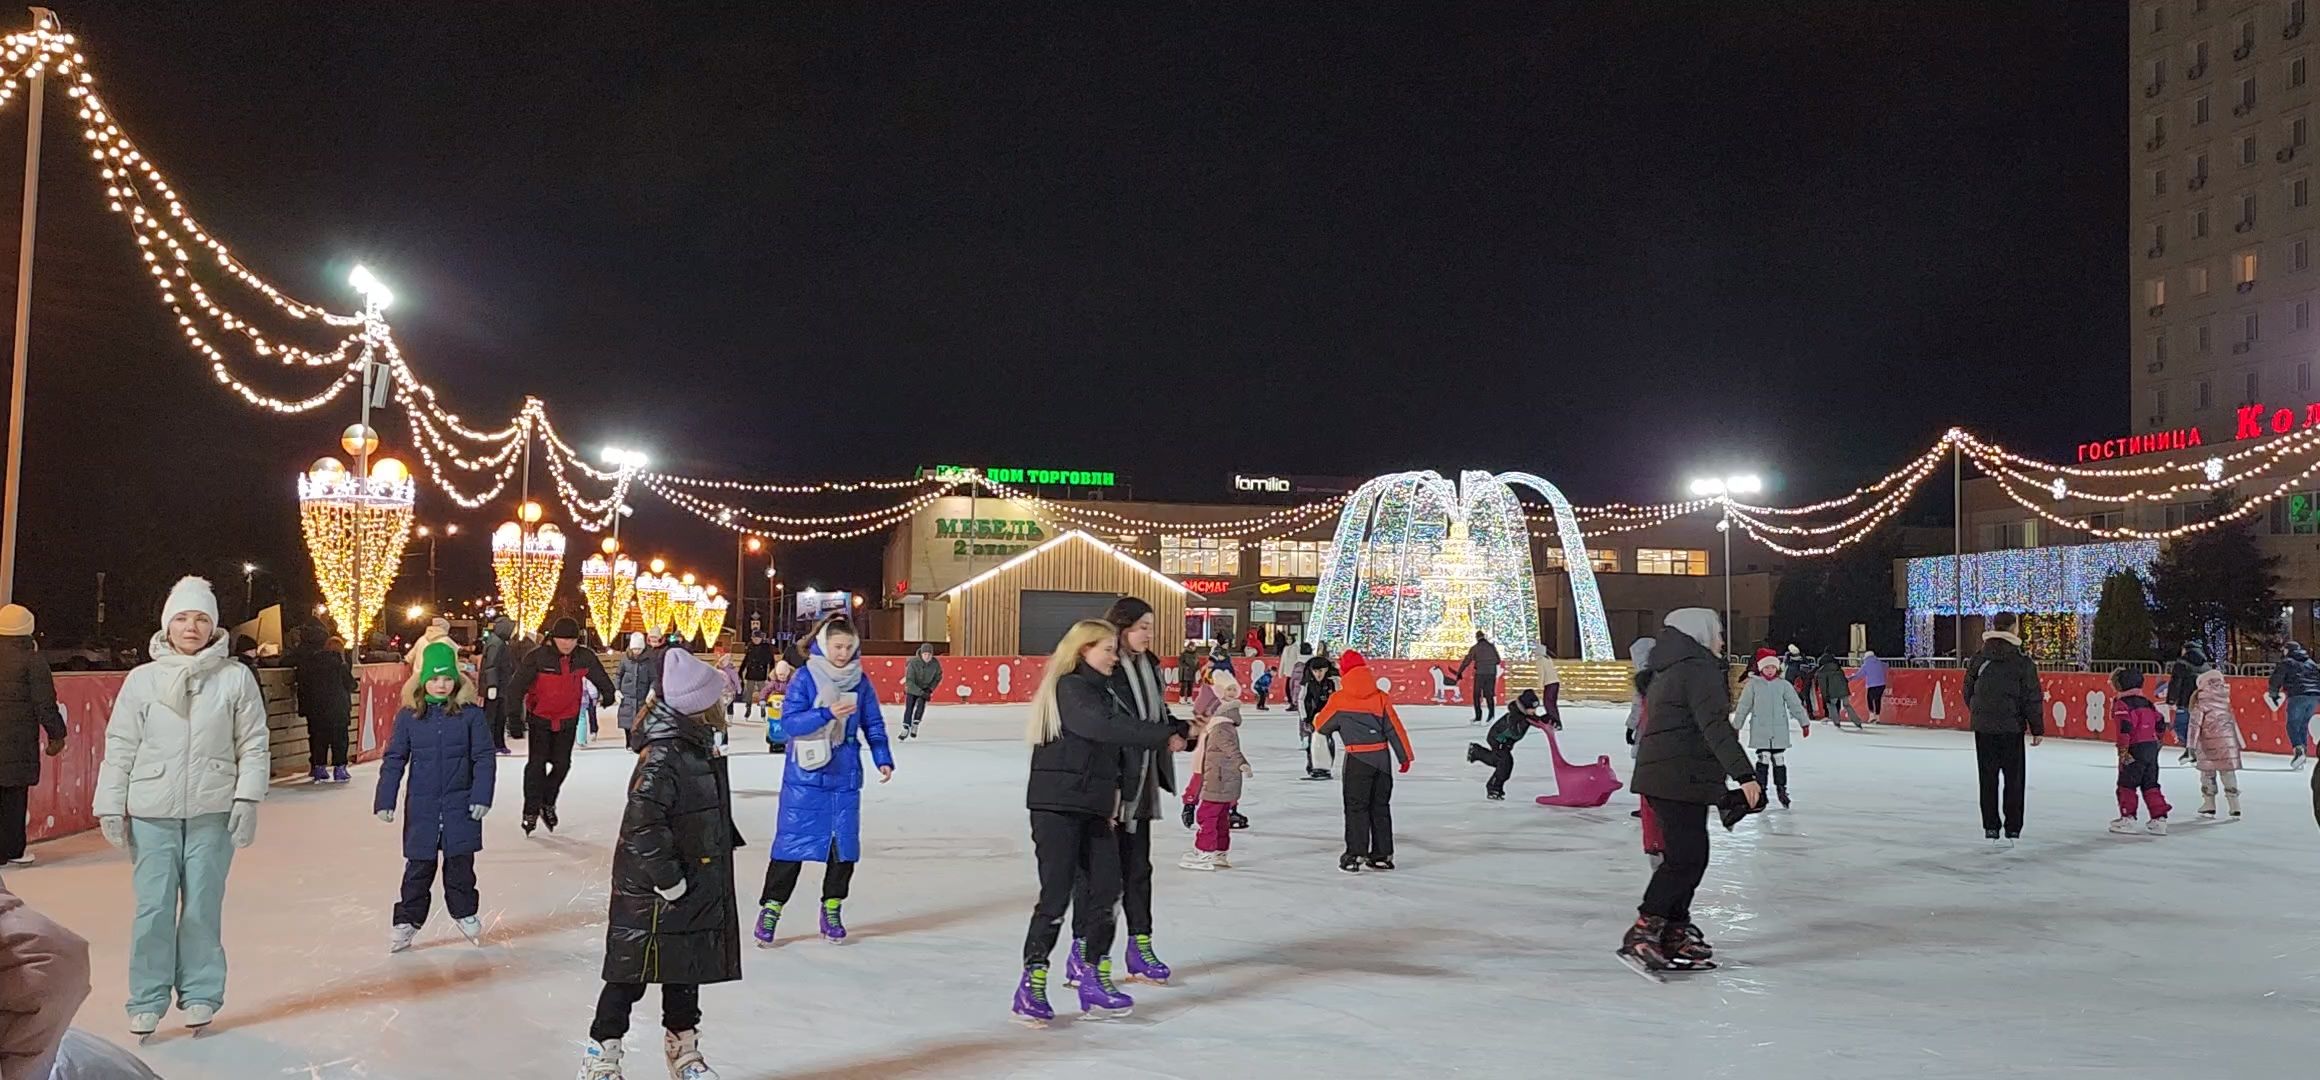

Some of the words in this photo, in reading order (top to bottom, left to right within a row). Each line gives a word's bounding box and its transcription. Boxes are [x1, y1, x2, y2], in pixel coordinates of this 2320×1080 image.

[2078, 426, 2202, 463] ГОСТИНИЦА
[1027, 469, 1115, 487] ТОРГОВЛИ
[1234, 474, 1291, 492] familia
[935, 518, 1044, 540] МЕБЕЛЬ
[953, 539, 968, 555] 2
